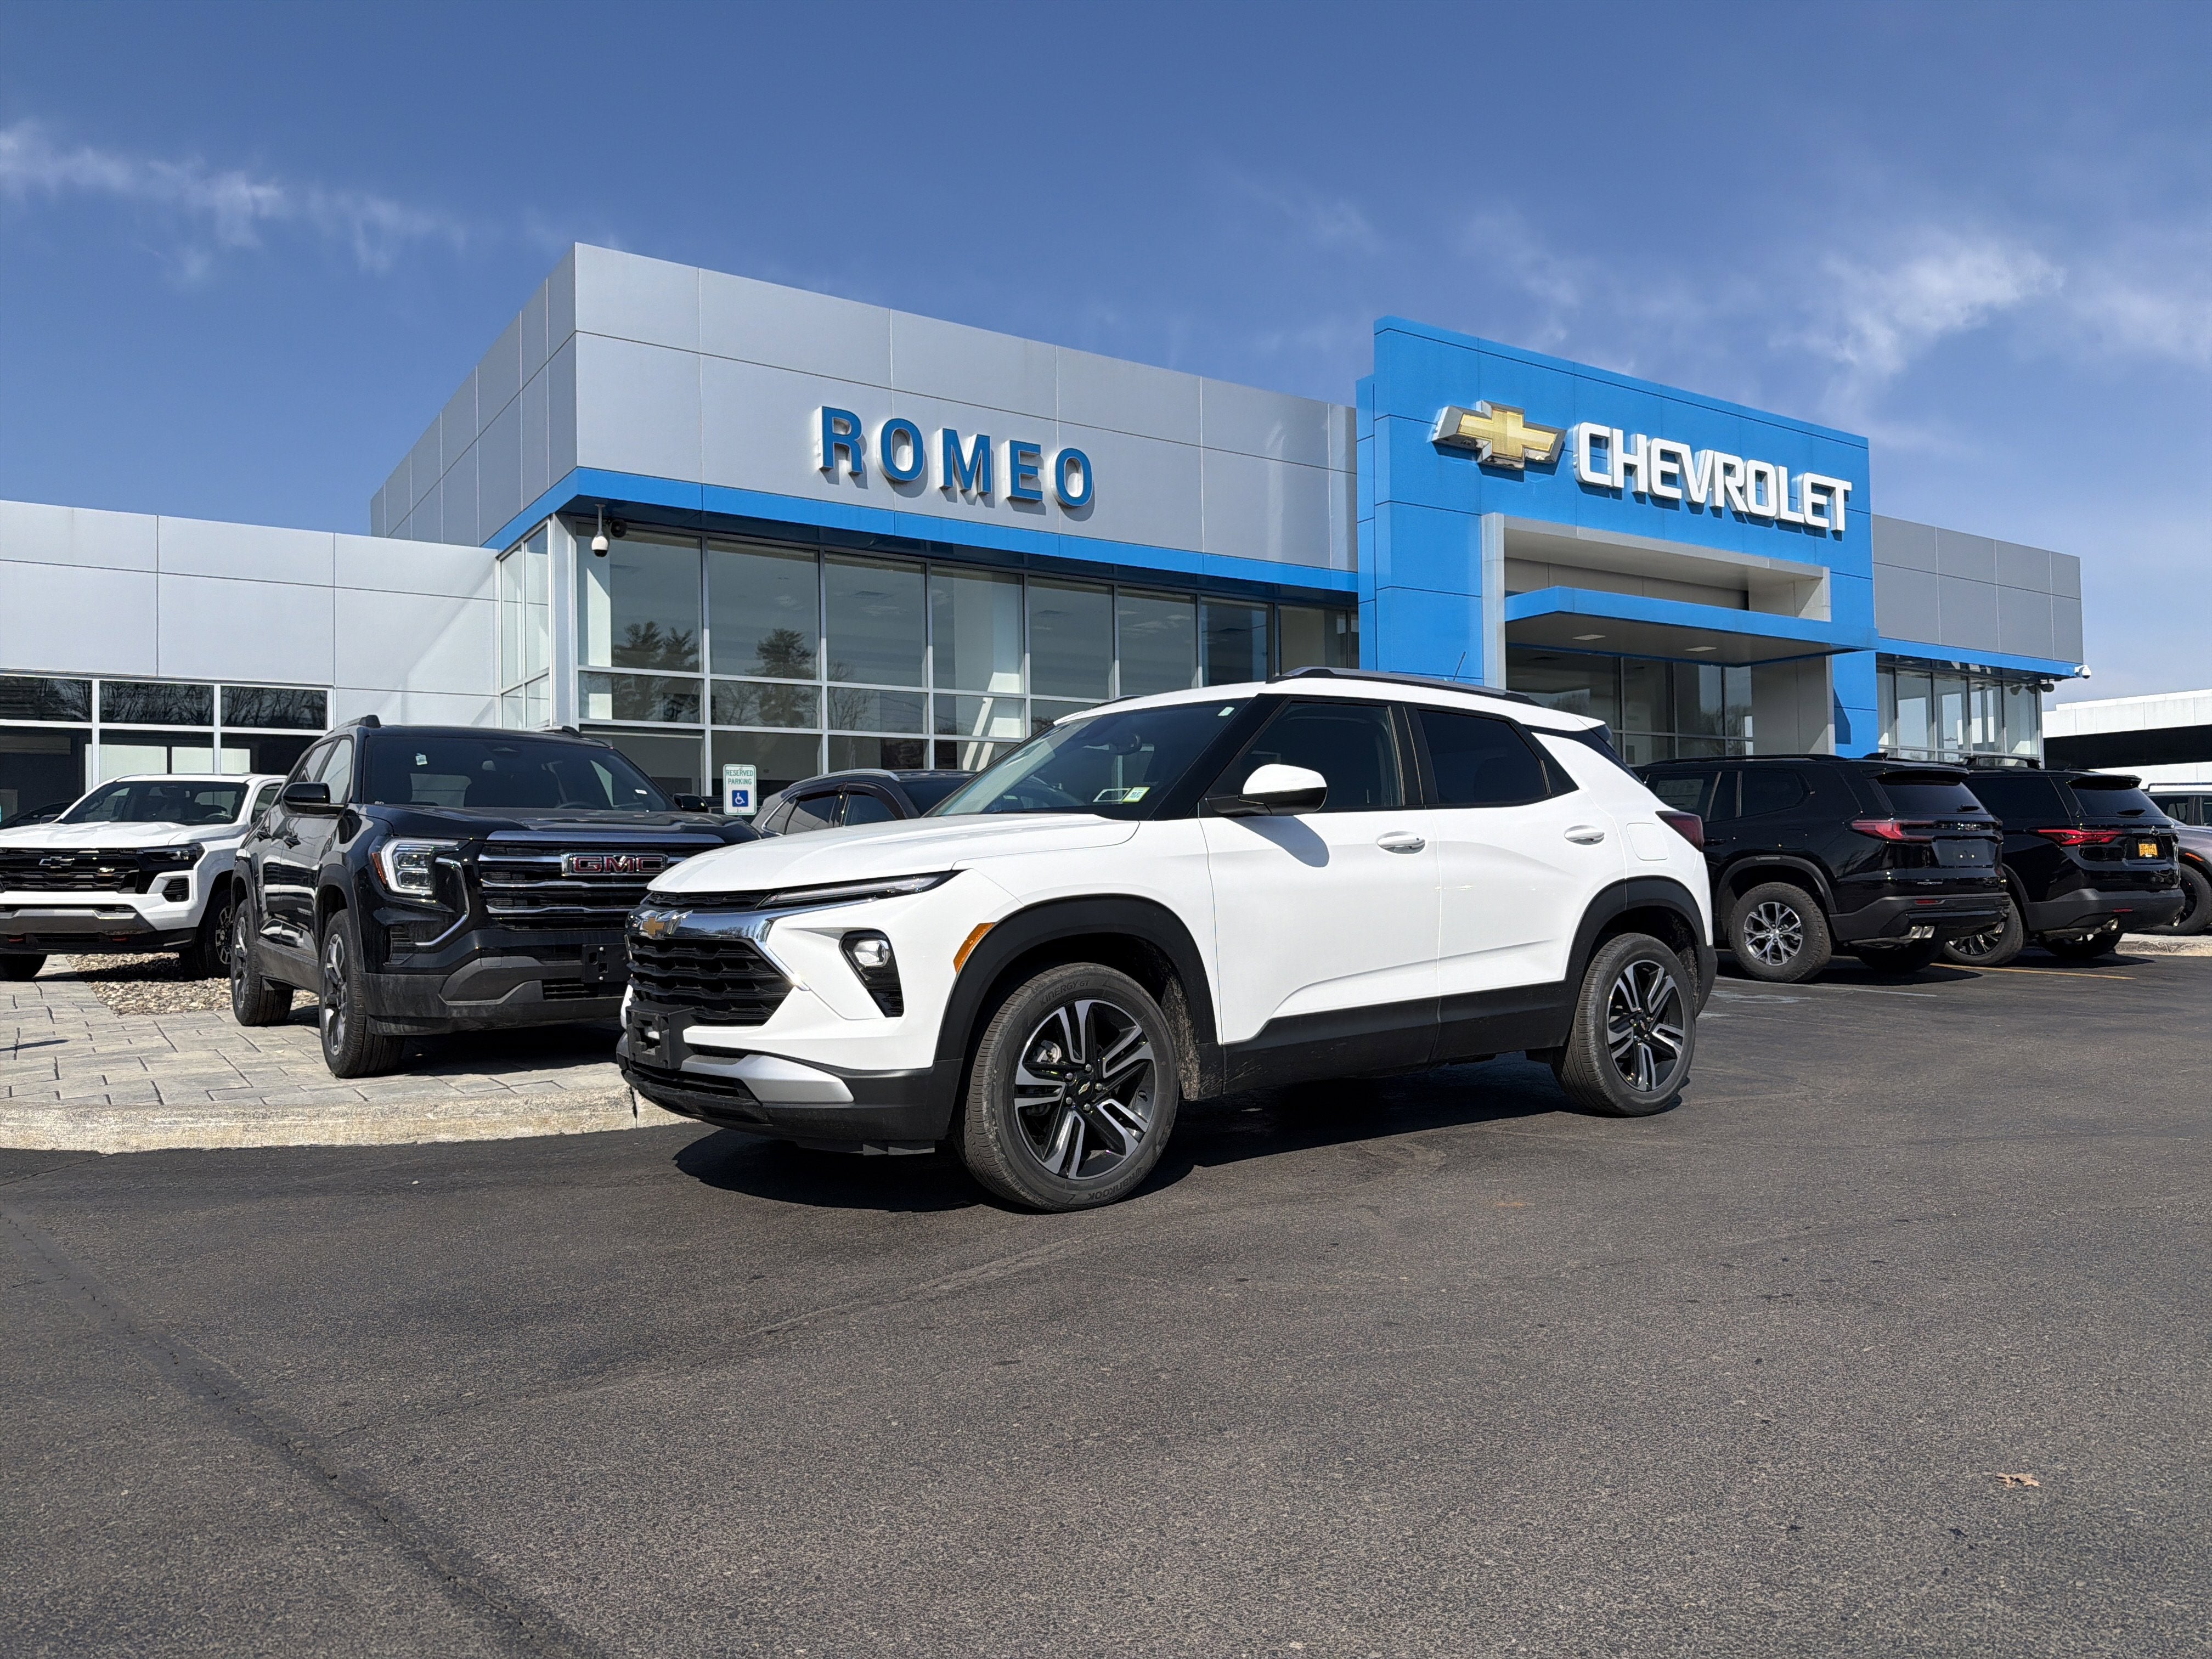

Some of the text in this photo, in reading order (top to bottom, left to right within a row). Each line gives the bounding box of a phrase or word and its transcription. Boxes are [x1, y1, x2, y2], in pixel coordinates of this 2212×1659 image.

[820, 405, 1093, 508] ROMEO
[1574, 421, 1852, 532] CHEVROLET
[573, 856, 664, 873] GMC
